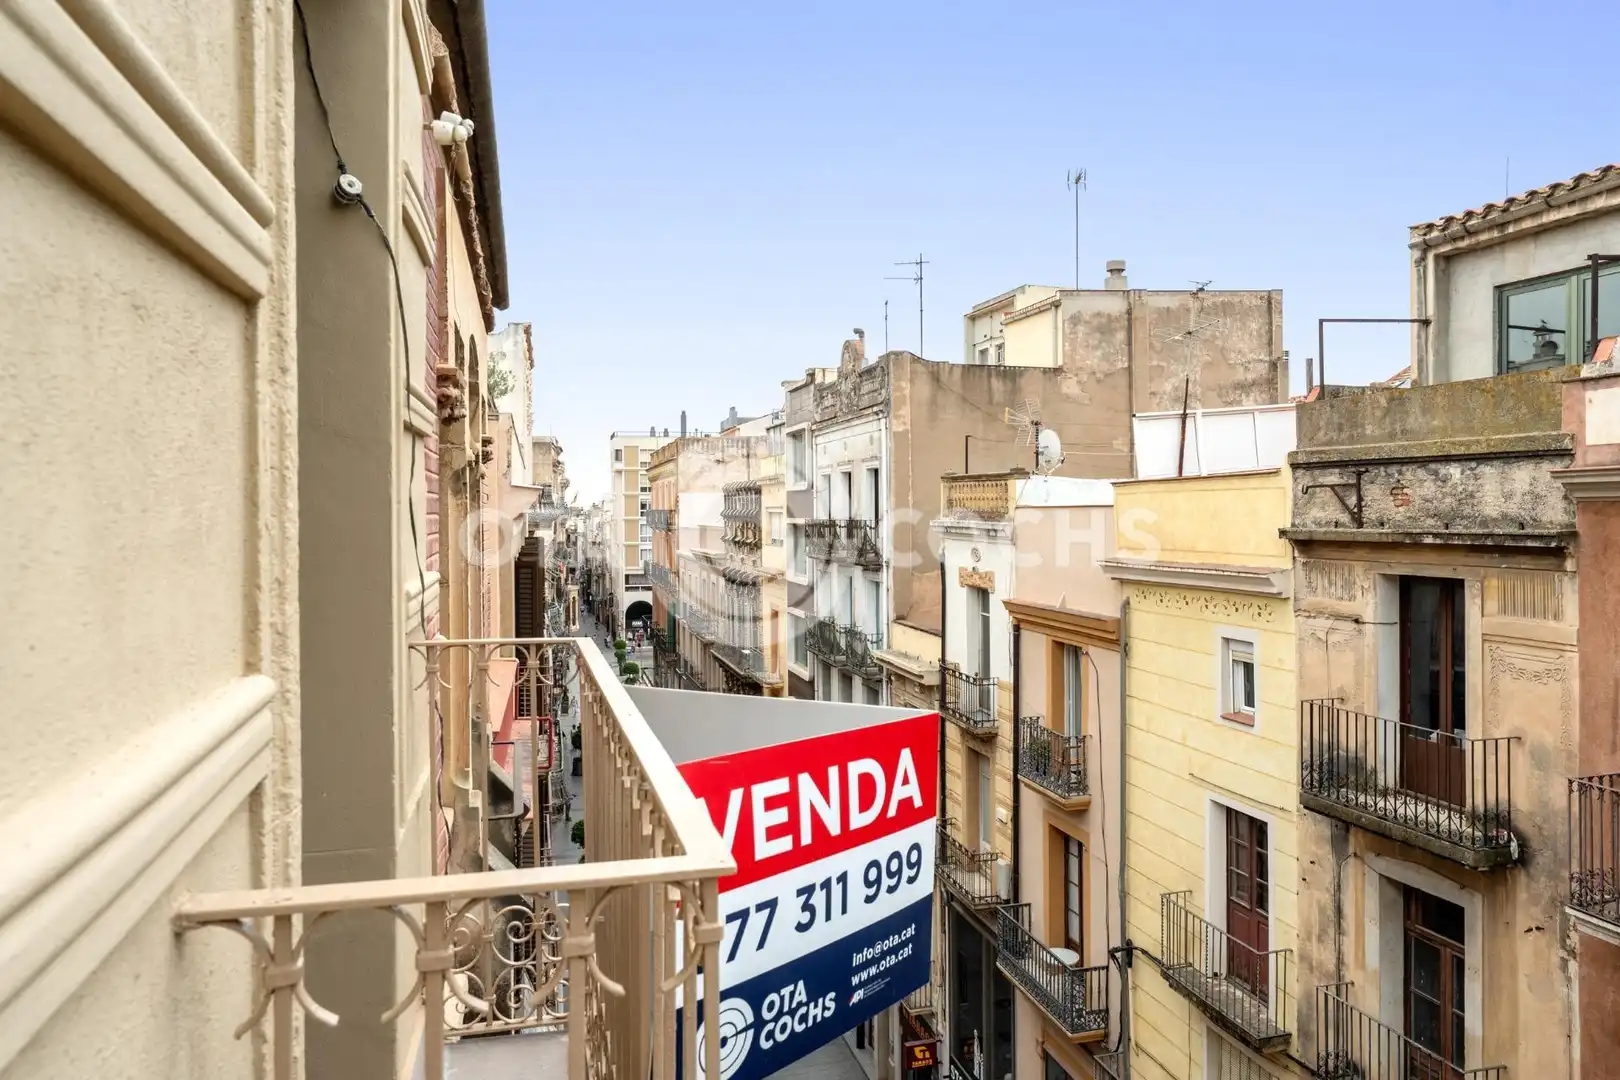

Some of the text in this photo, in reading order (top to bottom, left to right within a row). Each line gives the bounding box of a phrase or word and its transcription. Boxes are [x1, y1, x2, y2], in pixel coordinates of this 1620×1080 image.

[724, 842, 923, 964] 77 311 999
[851, 922, 916, 967] info@ota.cat
[851, 942, 913, 987] www.ota.cat
[759, 991, 837, 1050] COCHS
[760, 979, 808, 1021] OTA
